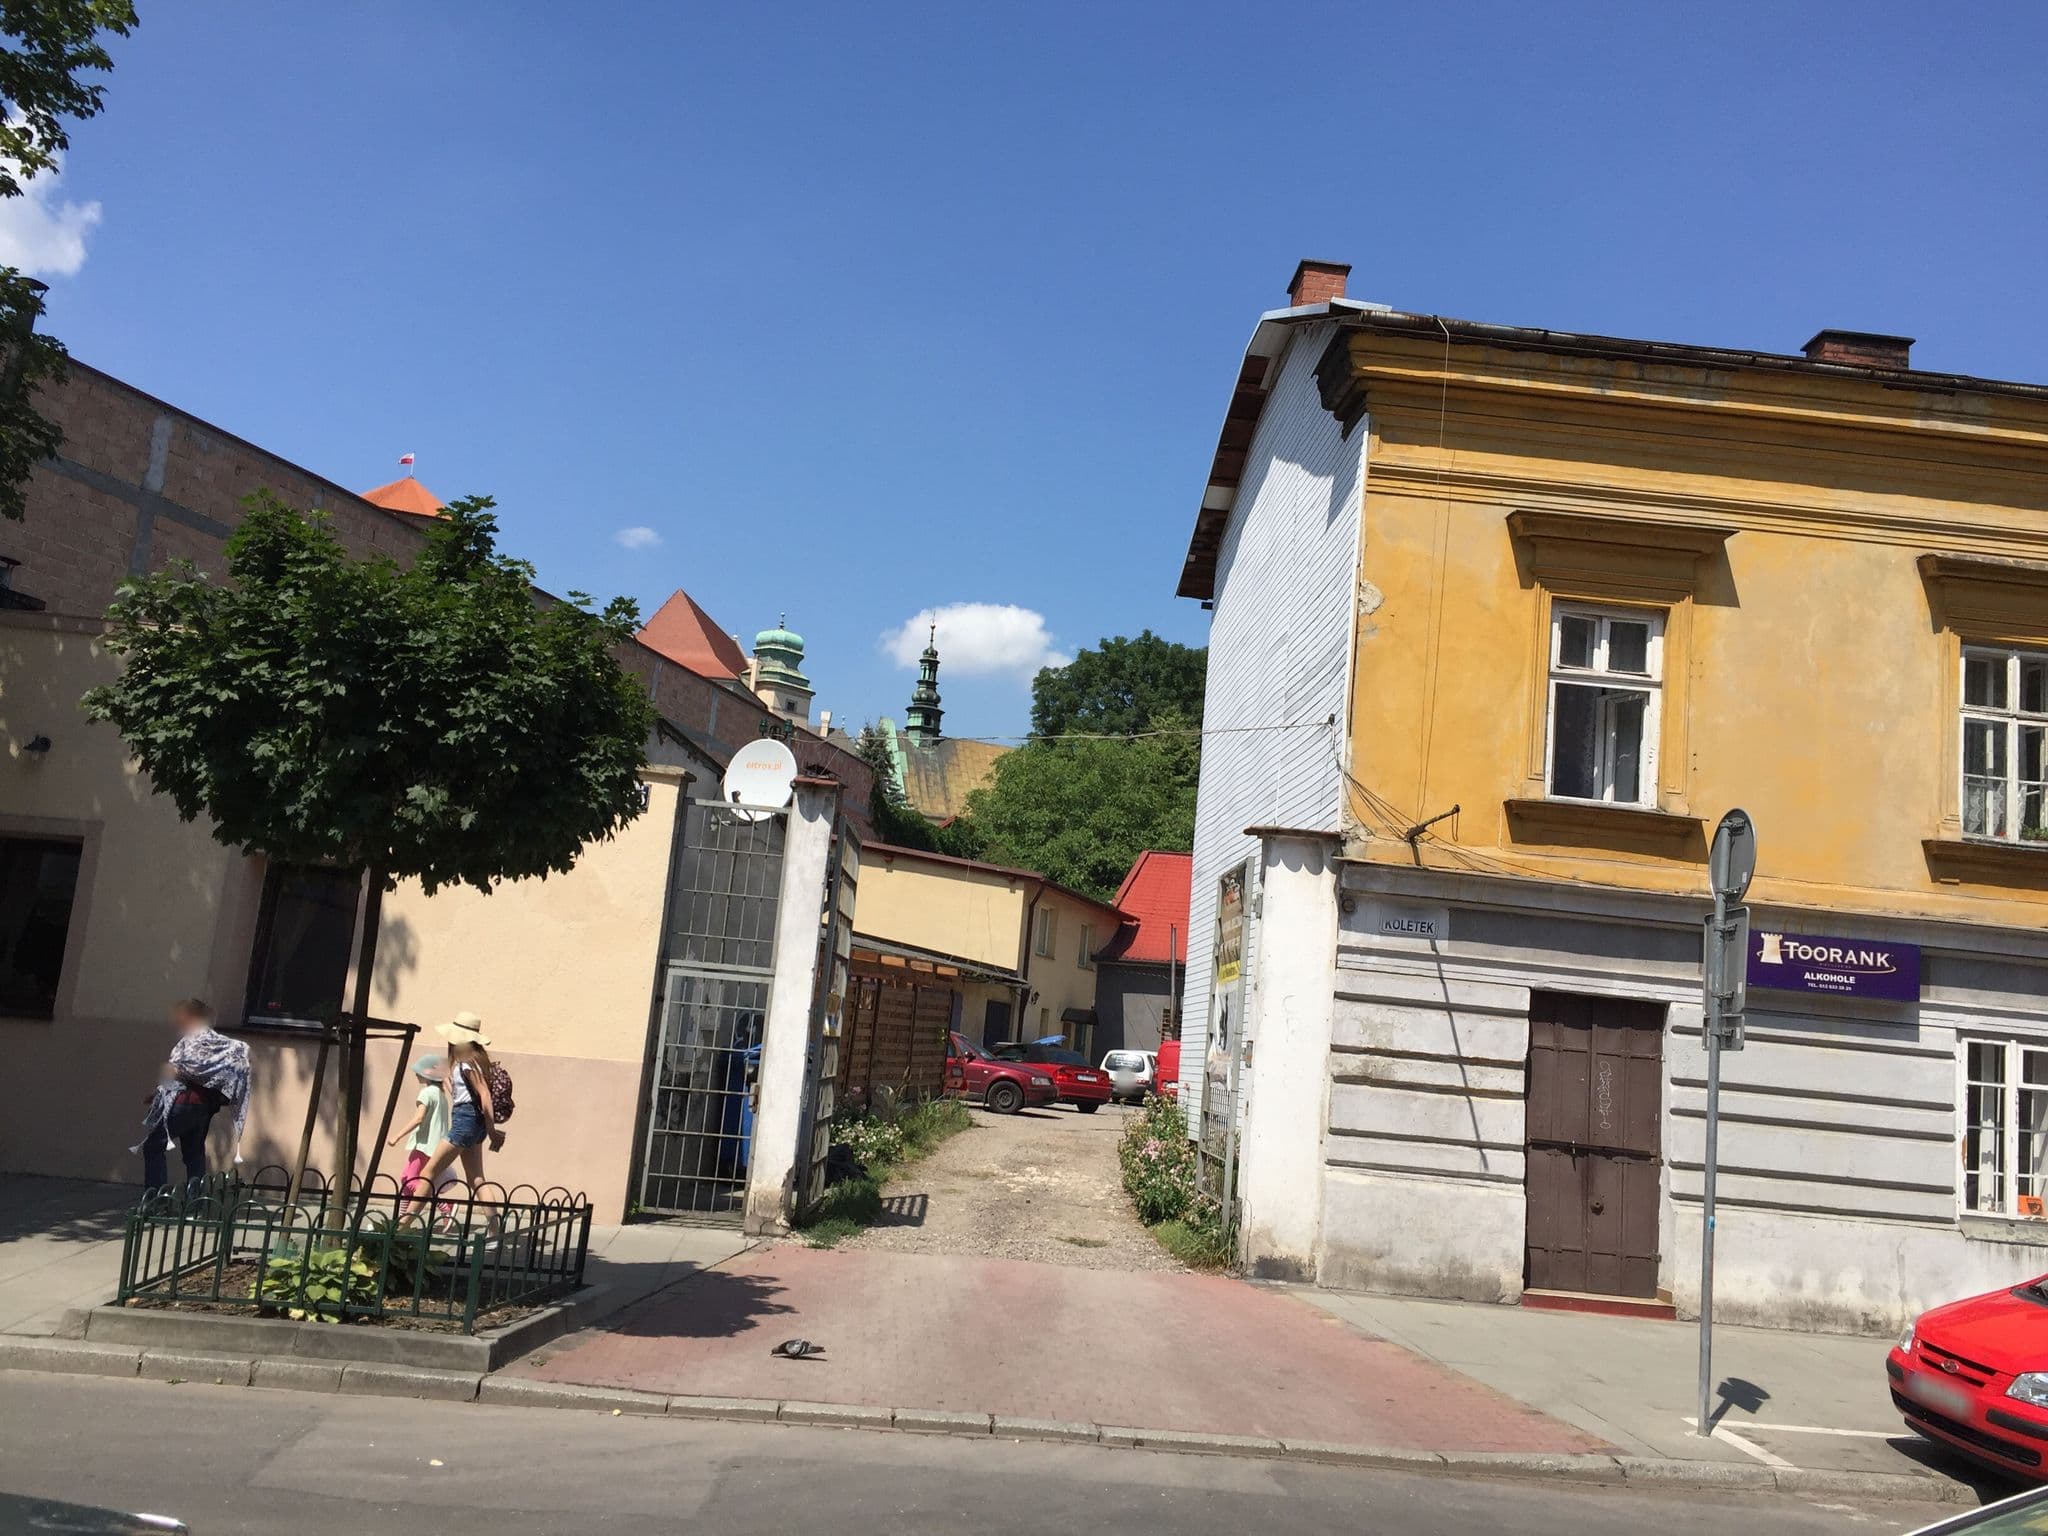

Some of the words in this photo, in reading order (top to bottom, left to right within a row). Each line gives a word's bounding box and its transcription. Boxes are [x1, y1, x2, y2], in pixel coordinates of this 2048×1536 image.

[1385, 919, 1434, 934] KOLETEK
[1783, 941, 1890, 967] TOORANK
[1804, 971, 1856, 984] ALKOHOLE
